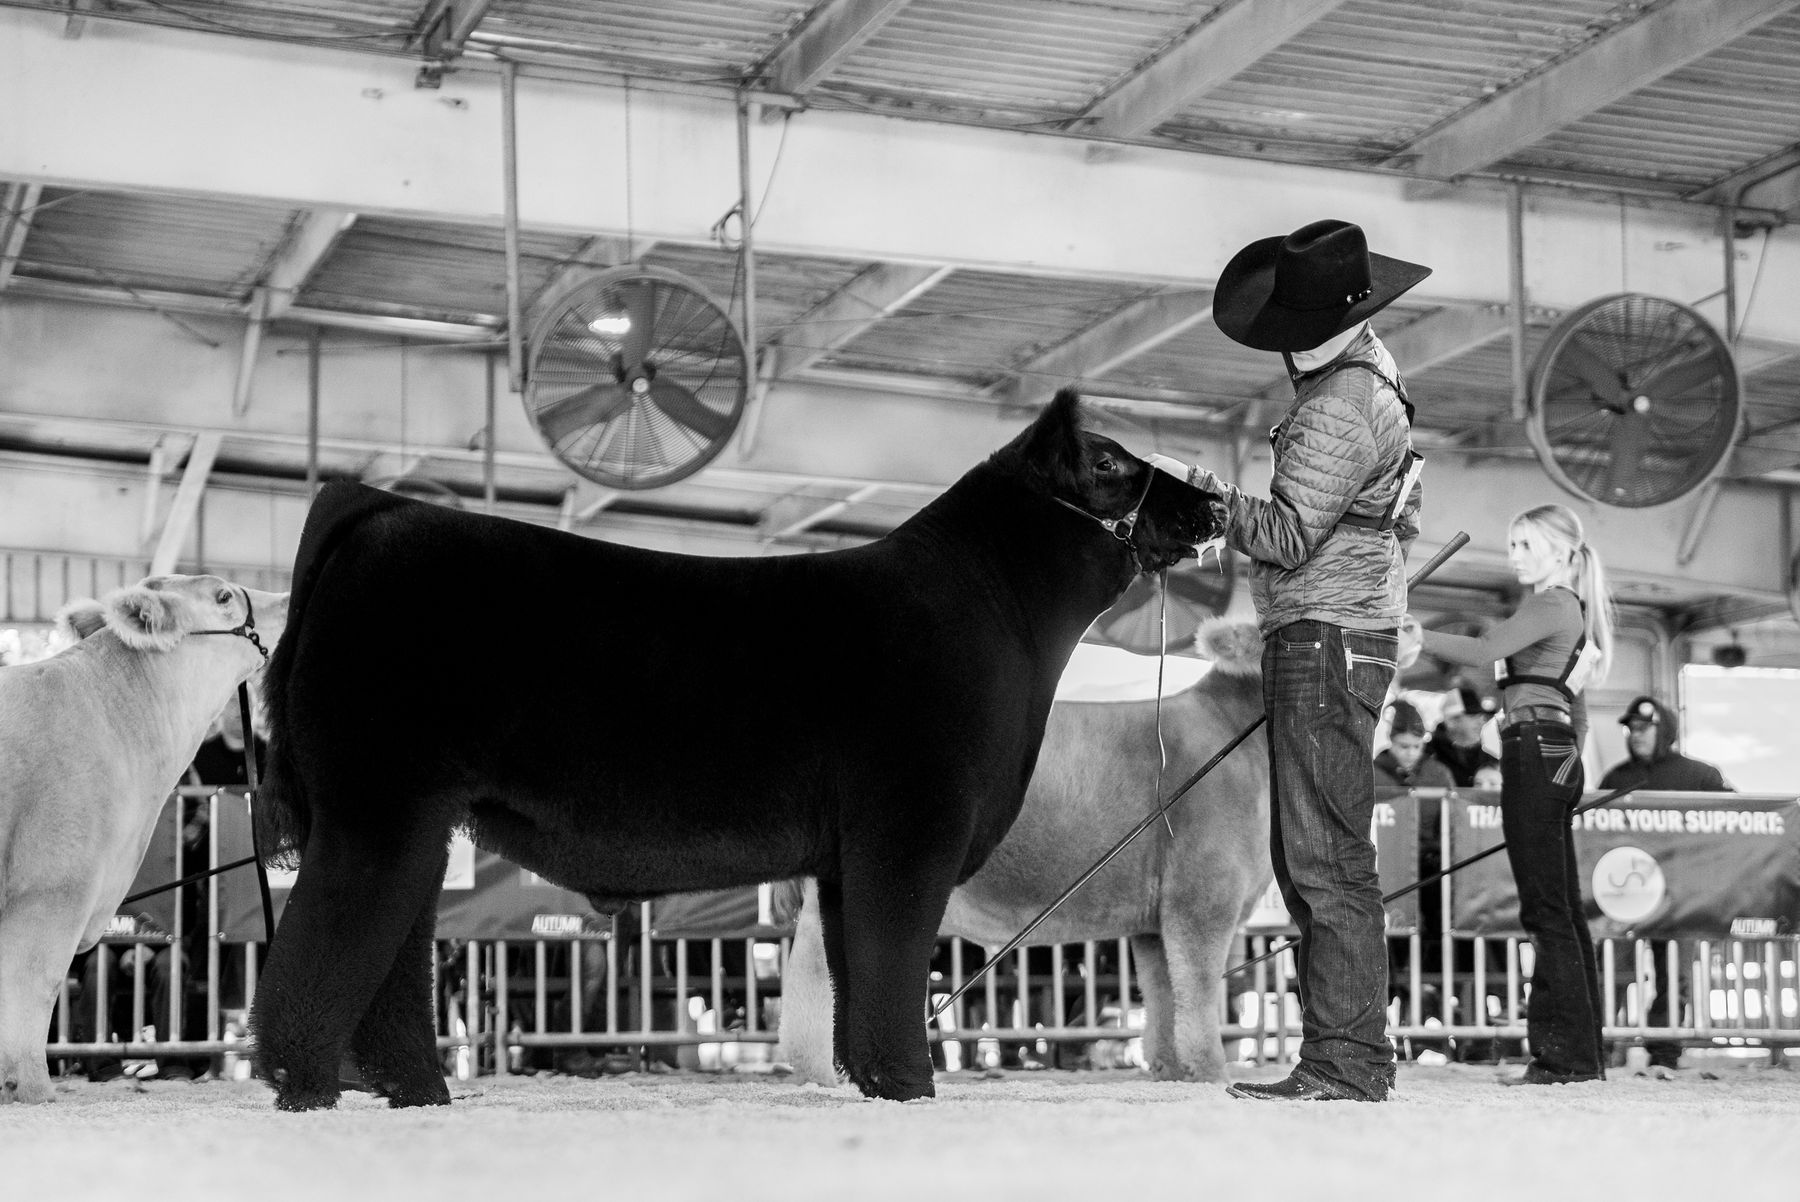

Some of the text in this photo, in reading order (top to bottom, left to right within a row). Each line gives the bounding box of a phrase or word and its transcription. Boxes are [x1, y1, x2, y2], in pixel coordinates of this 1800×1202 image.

[1468, 805, 1503, 829] THA
[1584, 808, 1625, 832] FOR
[1625, 809, 1683, 833] YOUR
[1685, 810, 1785, 836] SUPPORT:
